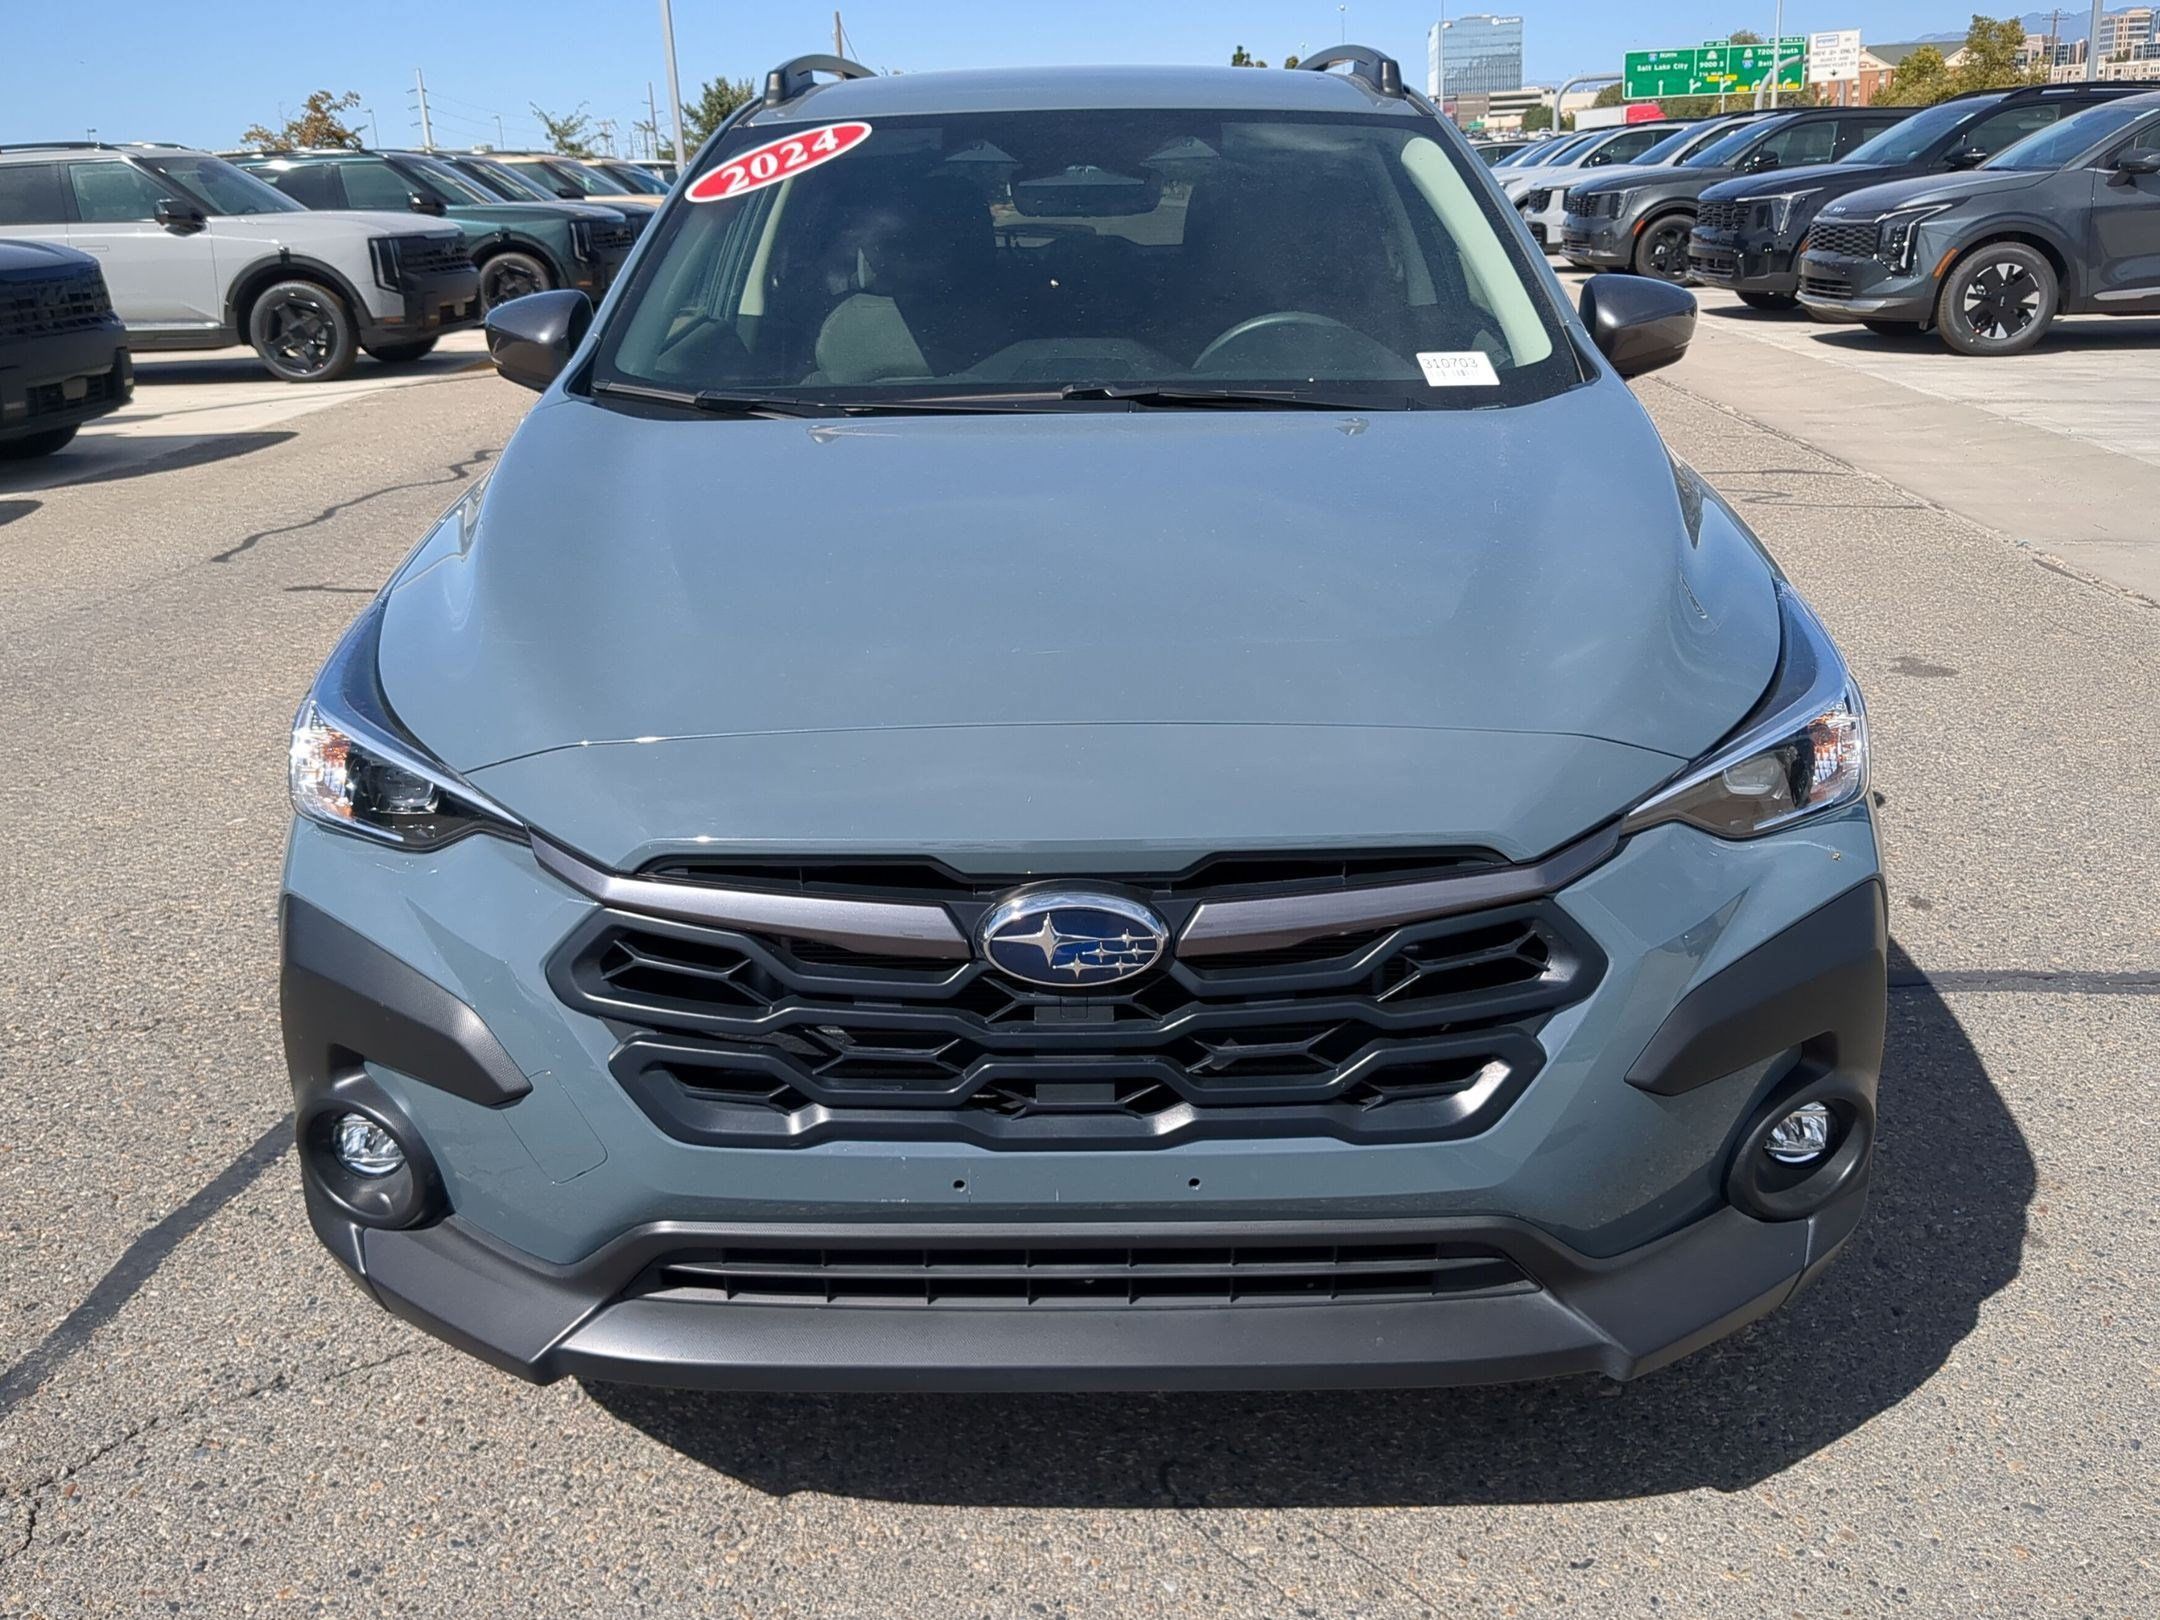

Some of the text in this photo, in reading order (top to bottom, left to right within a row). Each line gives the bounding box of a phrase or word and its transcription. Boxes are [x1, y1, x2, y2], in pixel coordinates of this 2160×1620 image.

[1637, 62, 1688, 72] Salt Lake City
[721, 128, 839, 194] 2024
